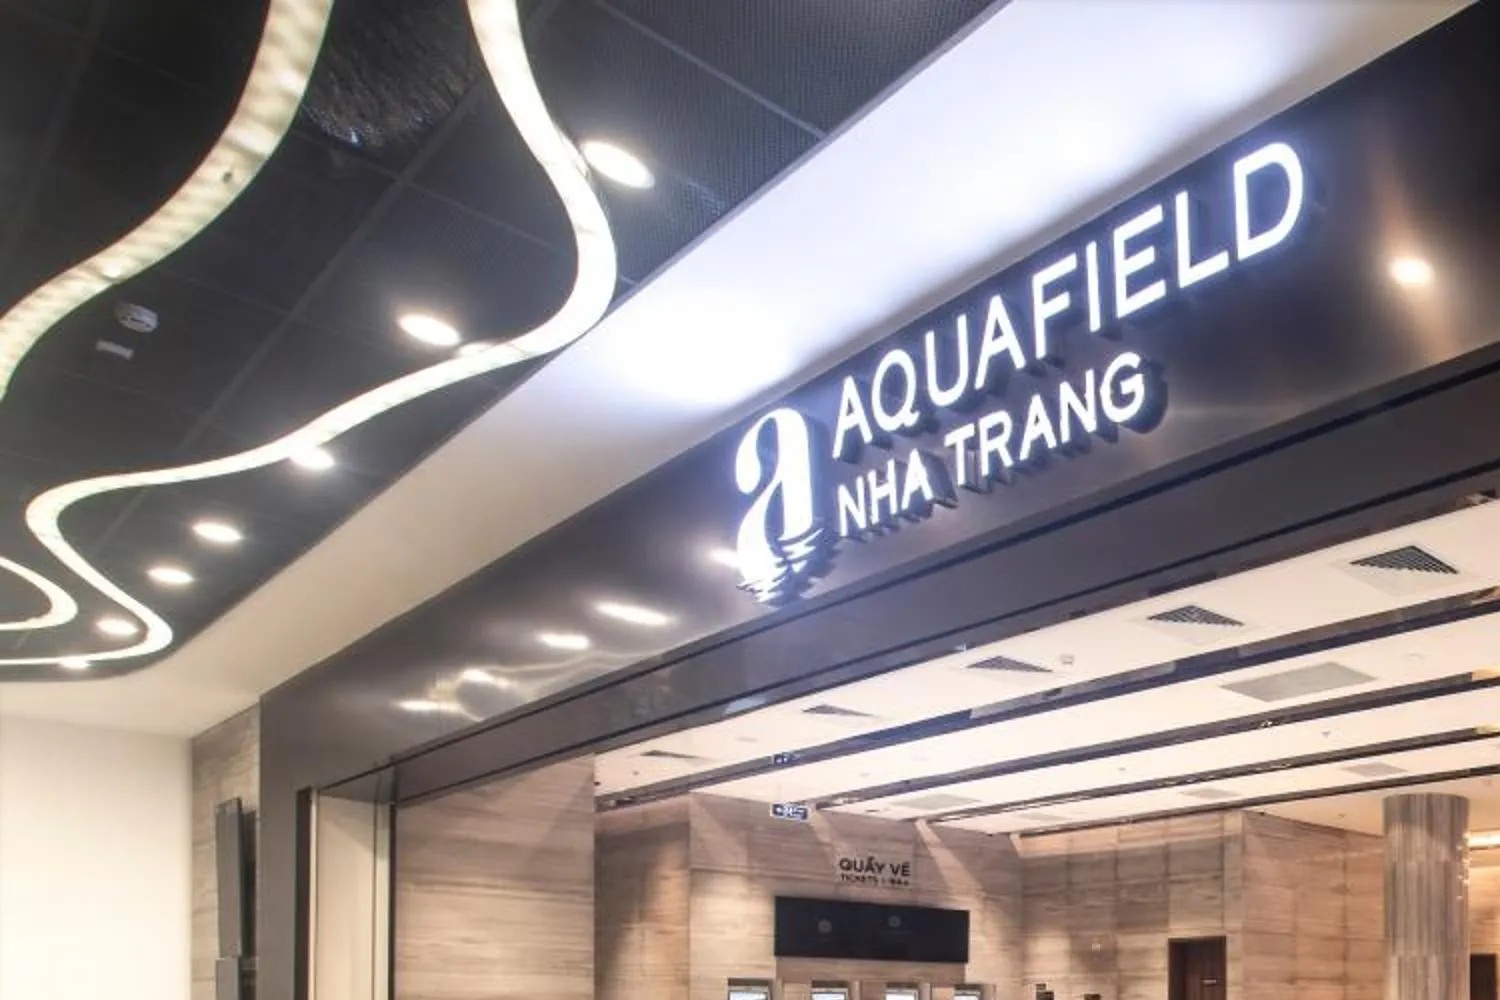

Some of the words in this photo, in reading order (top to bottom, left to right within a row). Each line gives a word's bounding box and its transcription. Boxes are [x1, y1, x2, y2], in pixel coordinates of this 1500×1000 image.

[832, 141, 1305, 459] AQUAFIELD
[836, 448, 934, 538] NHA
[944, 351, 1147, 487] TRANG
